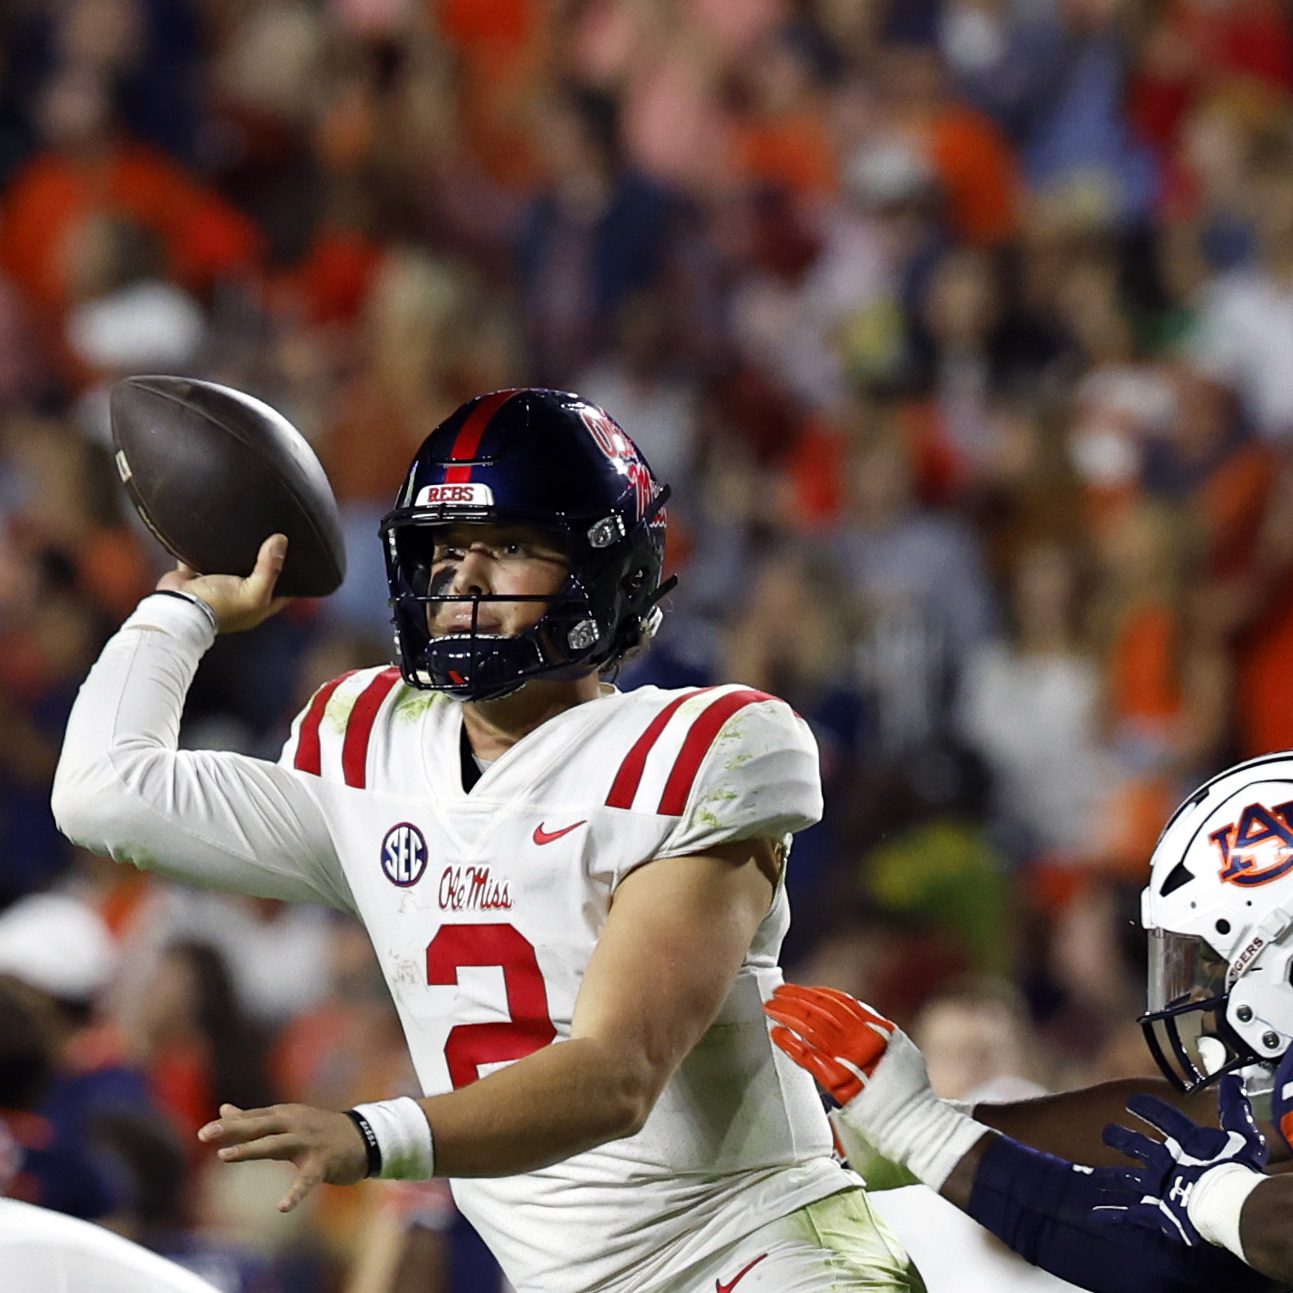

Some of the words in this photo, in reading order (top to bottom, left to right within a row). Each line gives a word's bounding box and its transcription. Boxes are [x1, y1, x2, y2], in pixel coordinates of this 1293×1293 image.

[428, 486, 474, 502] REBS
[384, 826, 424, 882] SEC
[438, 865, 465, 910] Ole
[465, 864, 513, 909] Miss
[425, 923, 558, 1092] 2
